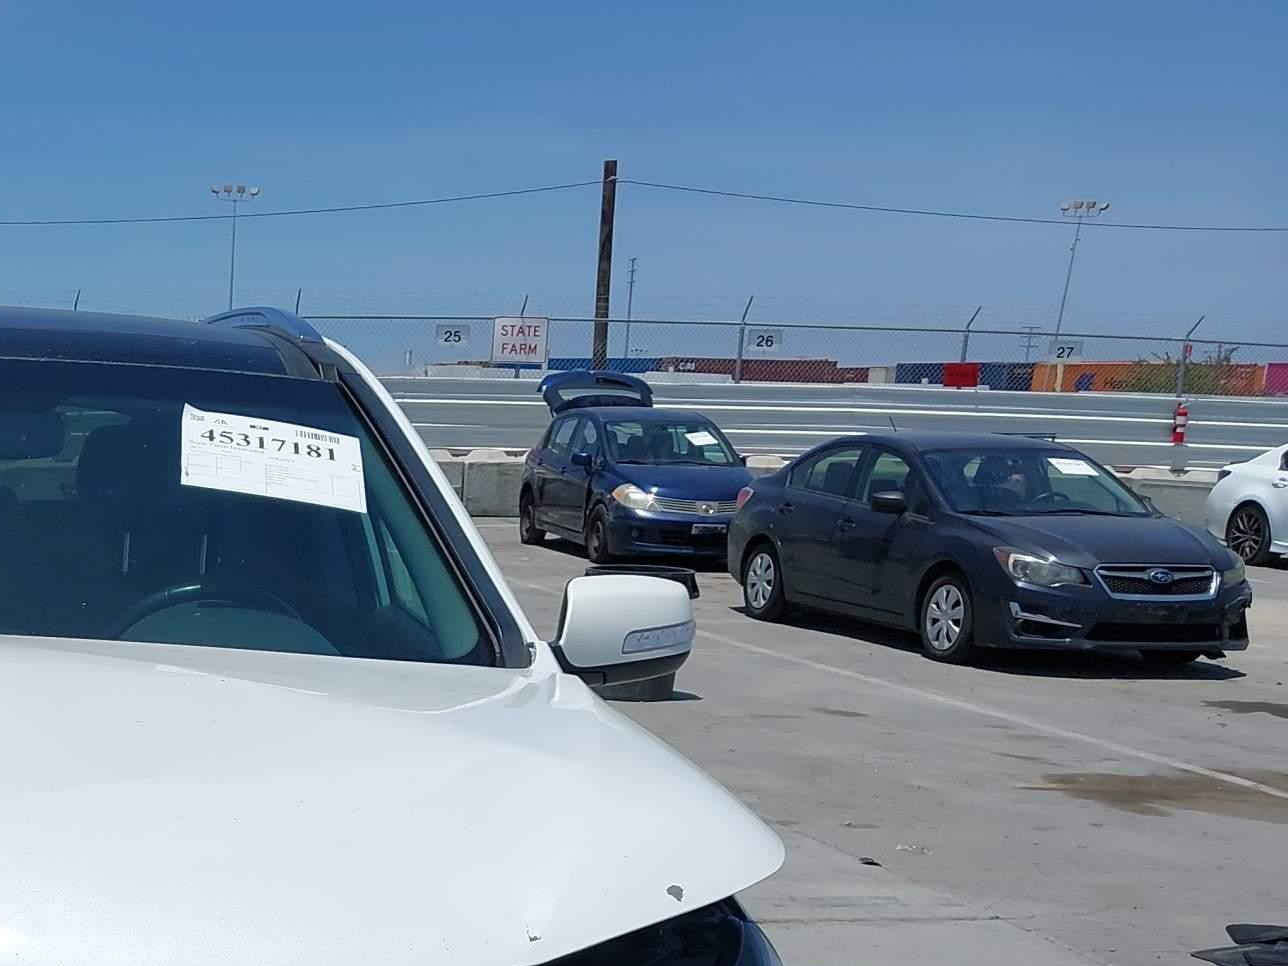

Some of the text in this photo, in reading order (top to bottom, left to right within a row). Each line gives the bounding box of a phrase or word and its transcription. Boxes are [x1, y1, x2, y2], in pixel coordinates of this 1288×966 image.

[444, 330, 462, 343] 25
[500, 325, 542, 337] STATE
[756, 335, 774, 347] 26
[501, 343, 538, 355] FARM
[1056, 346, 1075, 359] 27
[200, 428, 337, 462] 45317181
